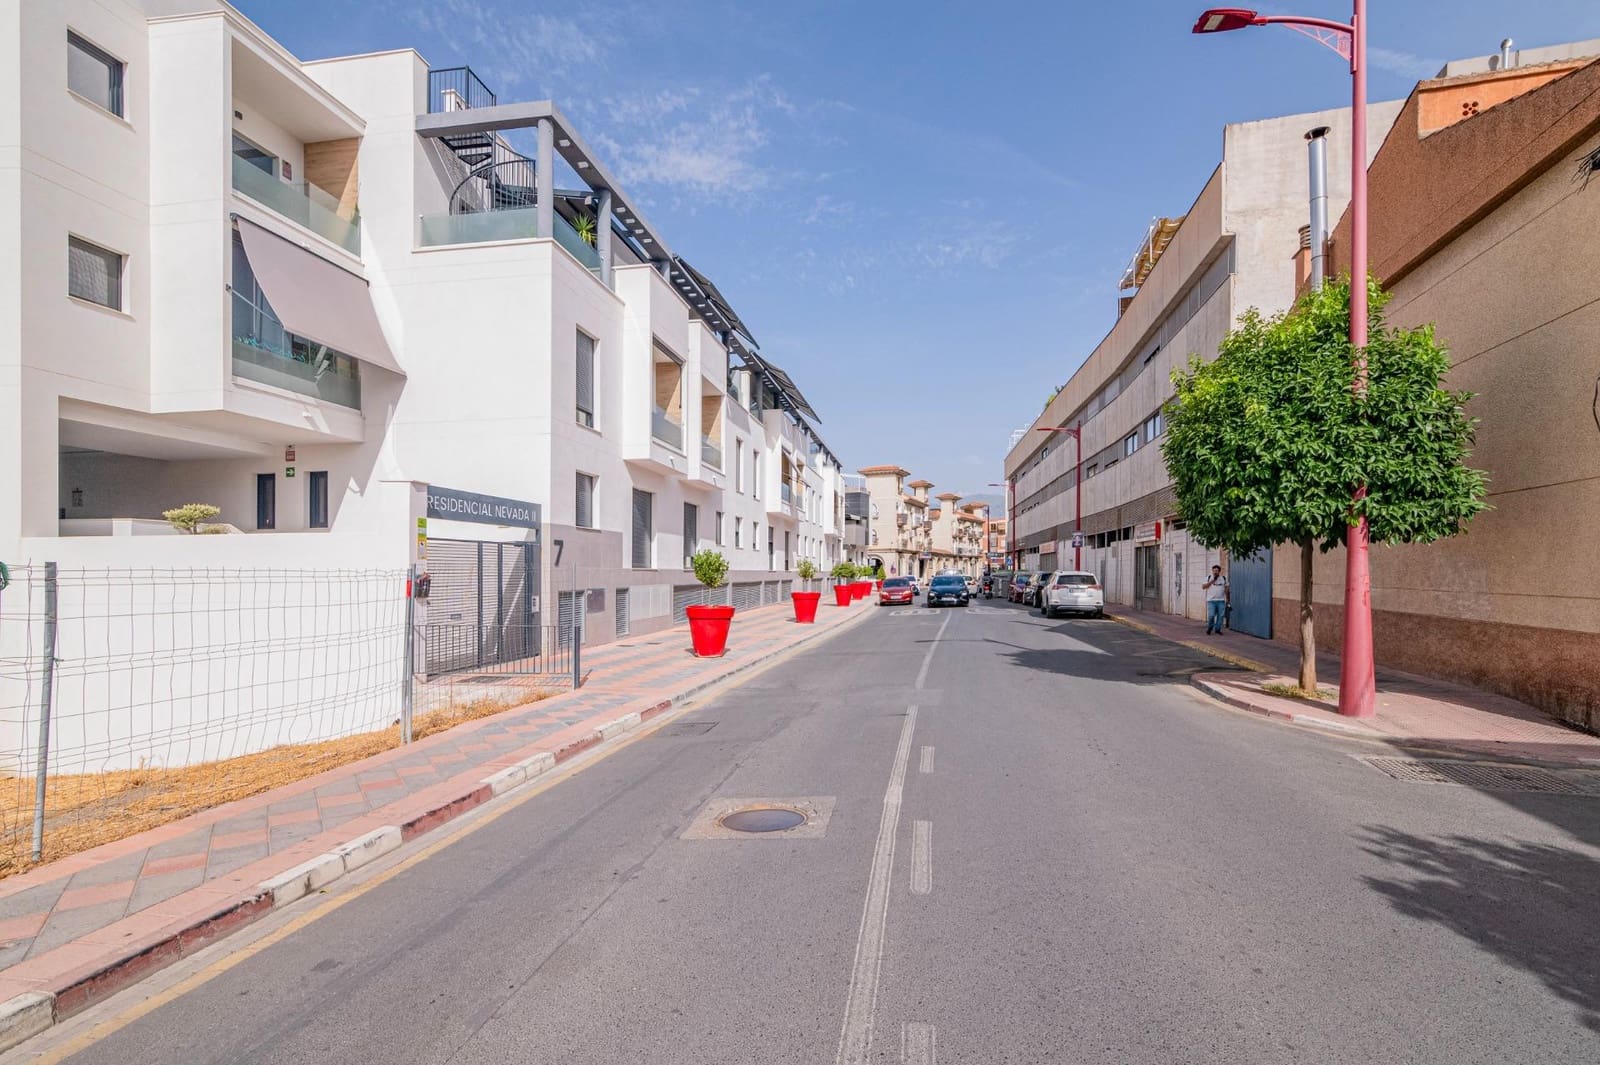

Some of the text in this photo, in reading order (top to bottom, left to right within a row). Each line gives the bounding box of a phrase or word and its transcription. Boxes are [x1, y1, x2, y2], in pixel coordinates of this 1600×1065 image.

[427, 495, 493, 516] RESIDENCIAL
[495, 506, 529, 521] NEVADA
[553, 540, 564, 566] 7
